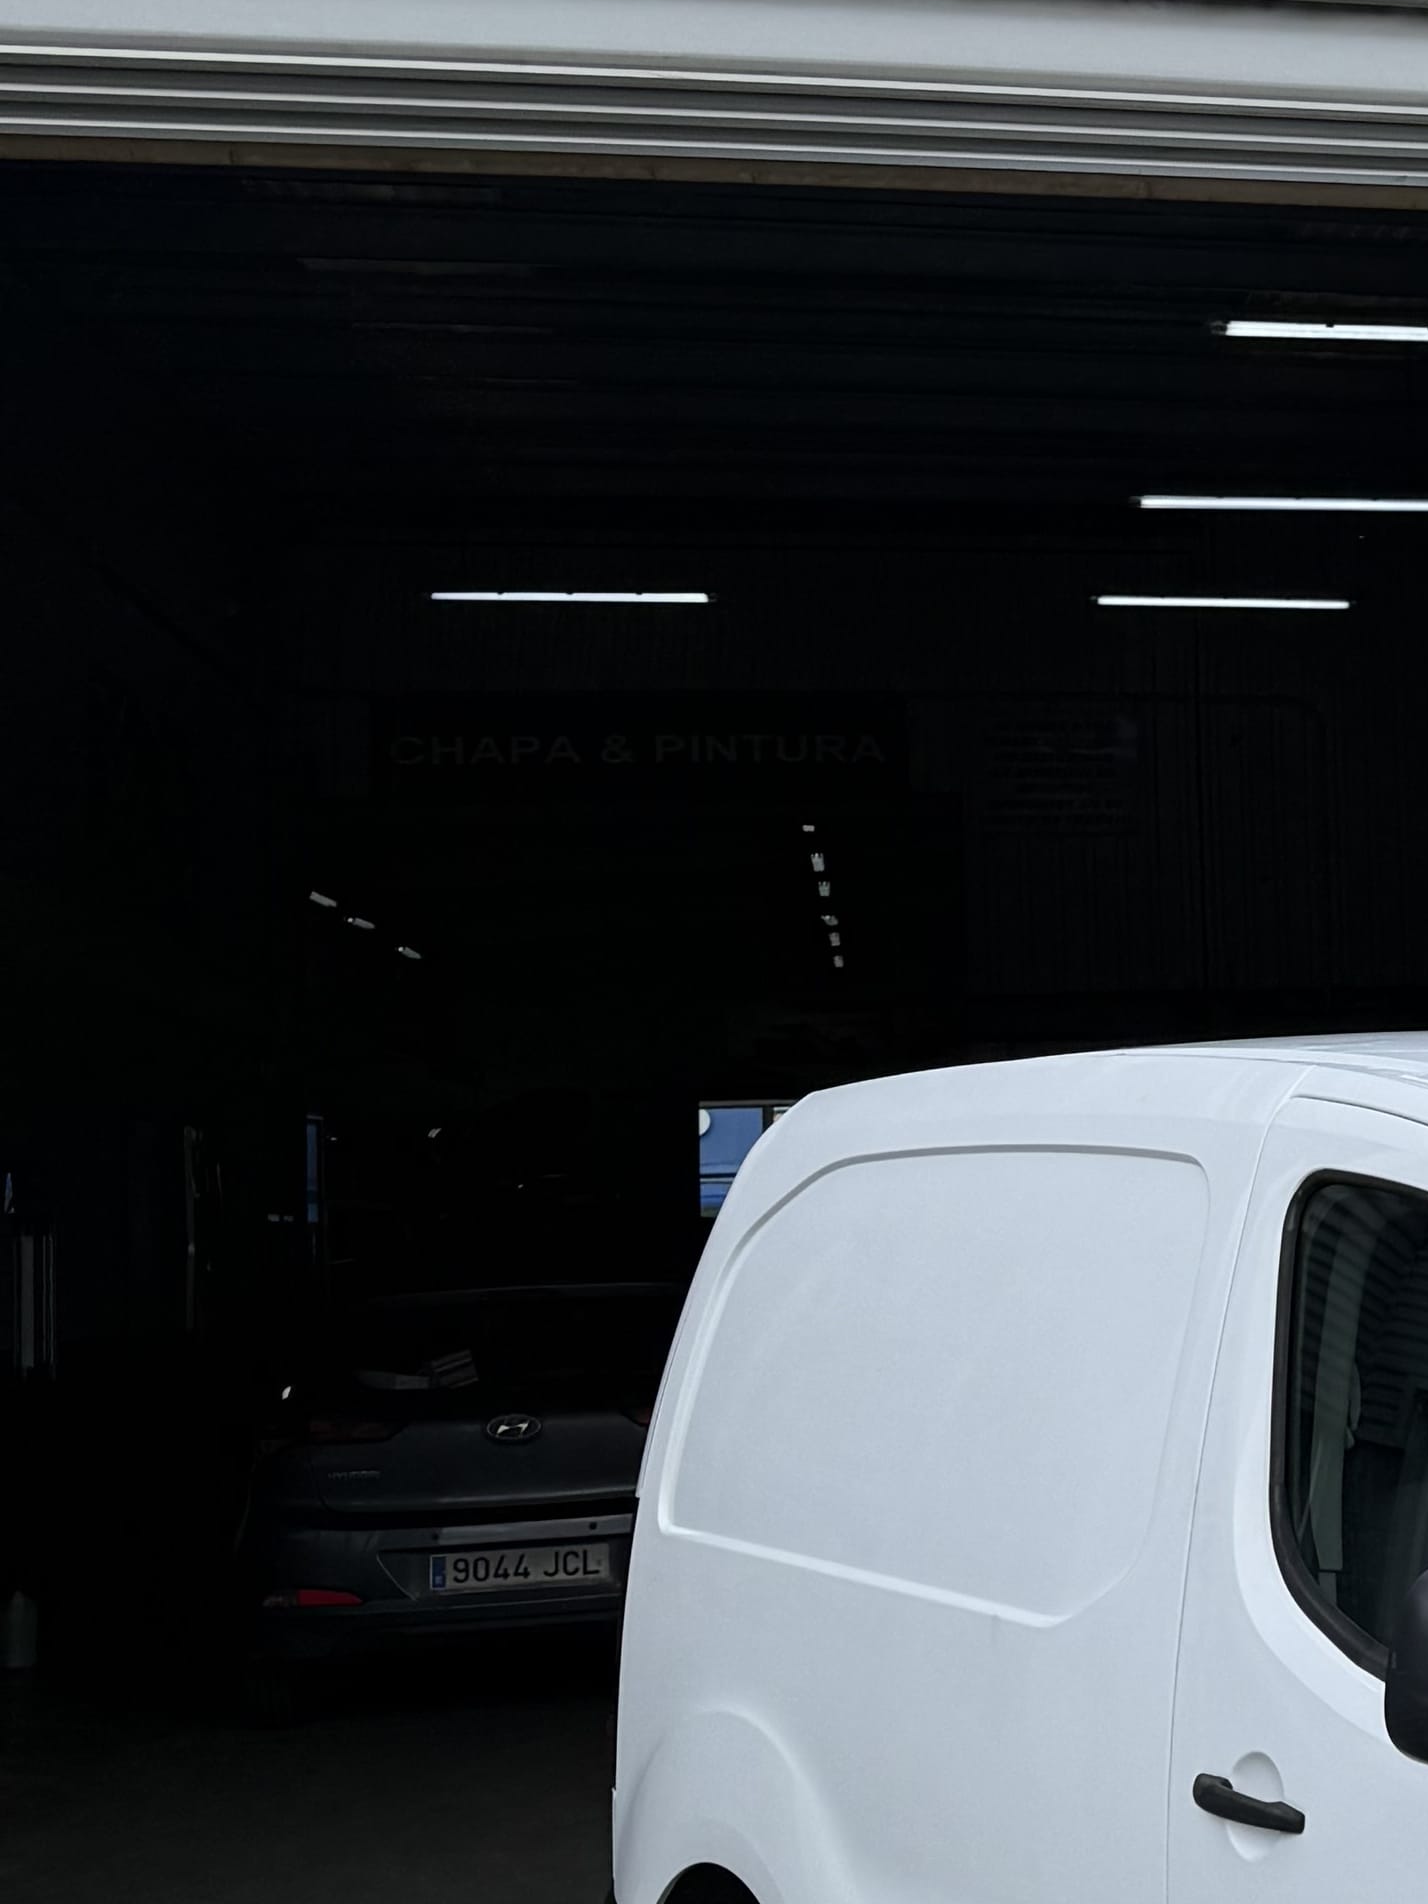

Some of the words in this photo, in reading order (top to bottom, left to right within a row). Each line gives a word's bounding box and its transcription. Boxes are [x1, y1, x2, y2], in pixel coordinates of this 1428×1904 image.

[388, 734, 582, 767] CHAPA
[600, 733, 637, 766] &
[655, 732, 886, 765] PINTURA
[453, 1553, 531, 1584] 9044
[543, 1549, 601, 1578] JCL
